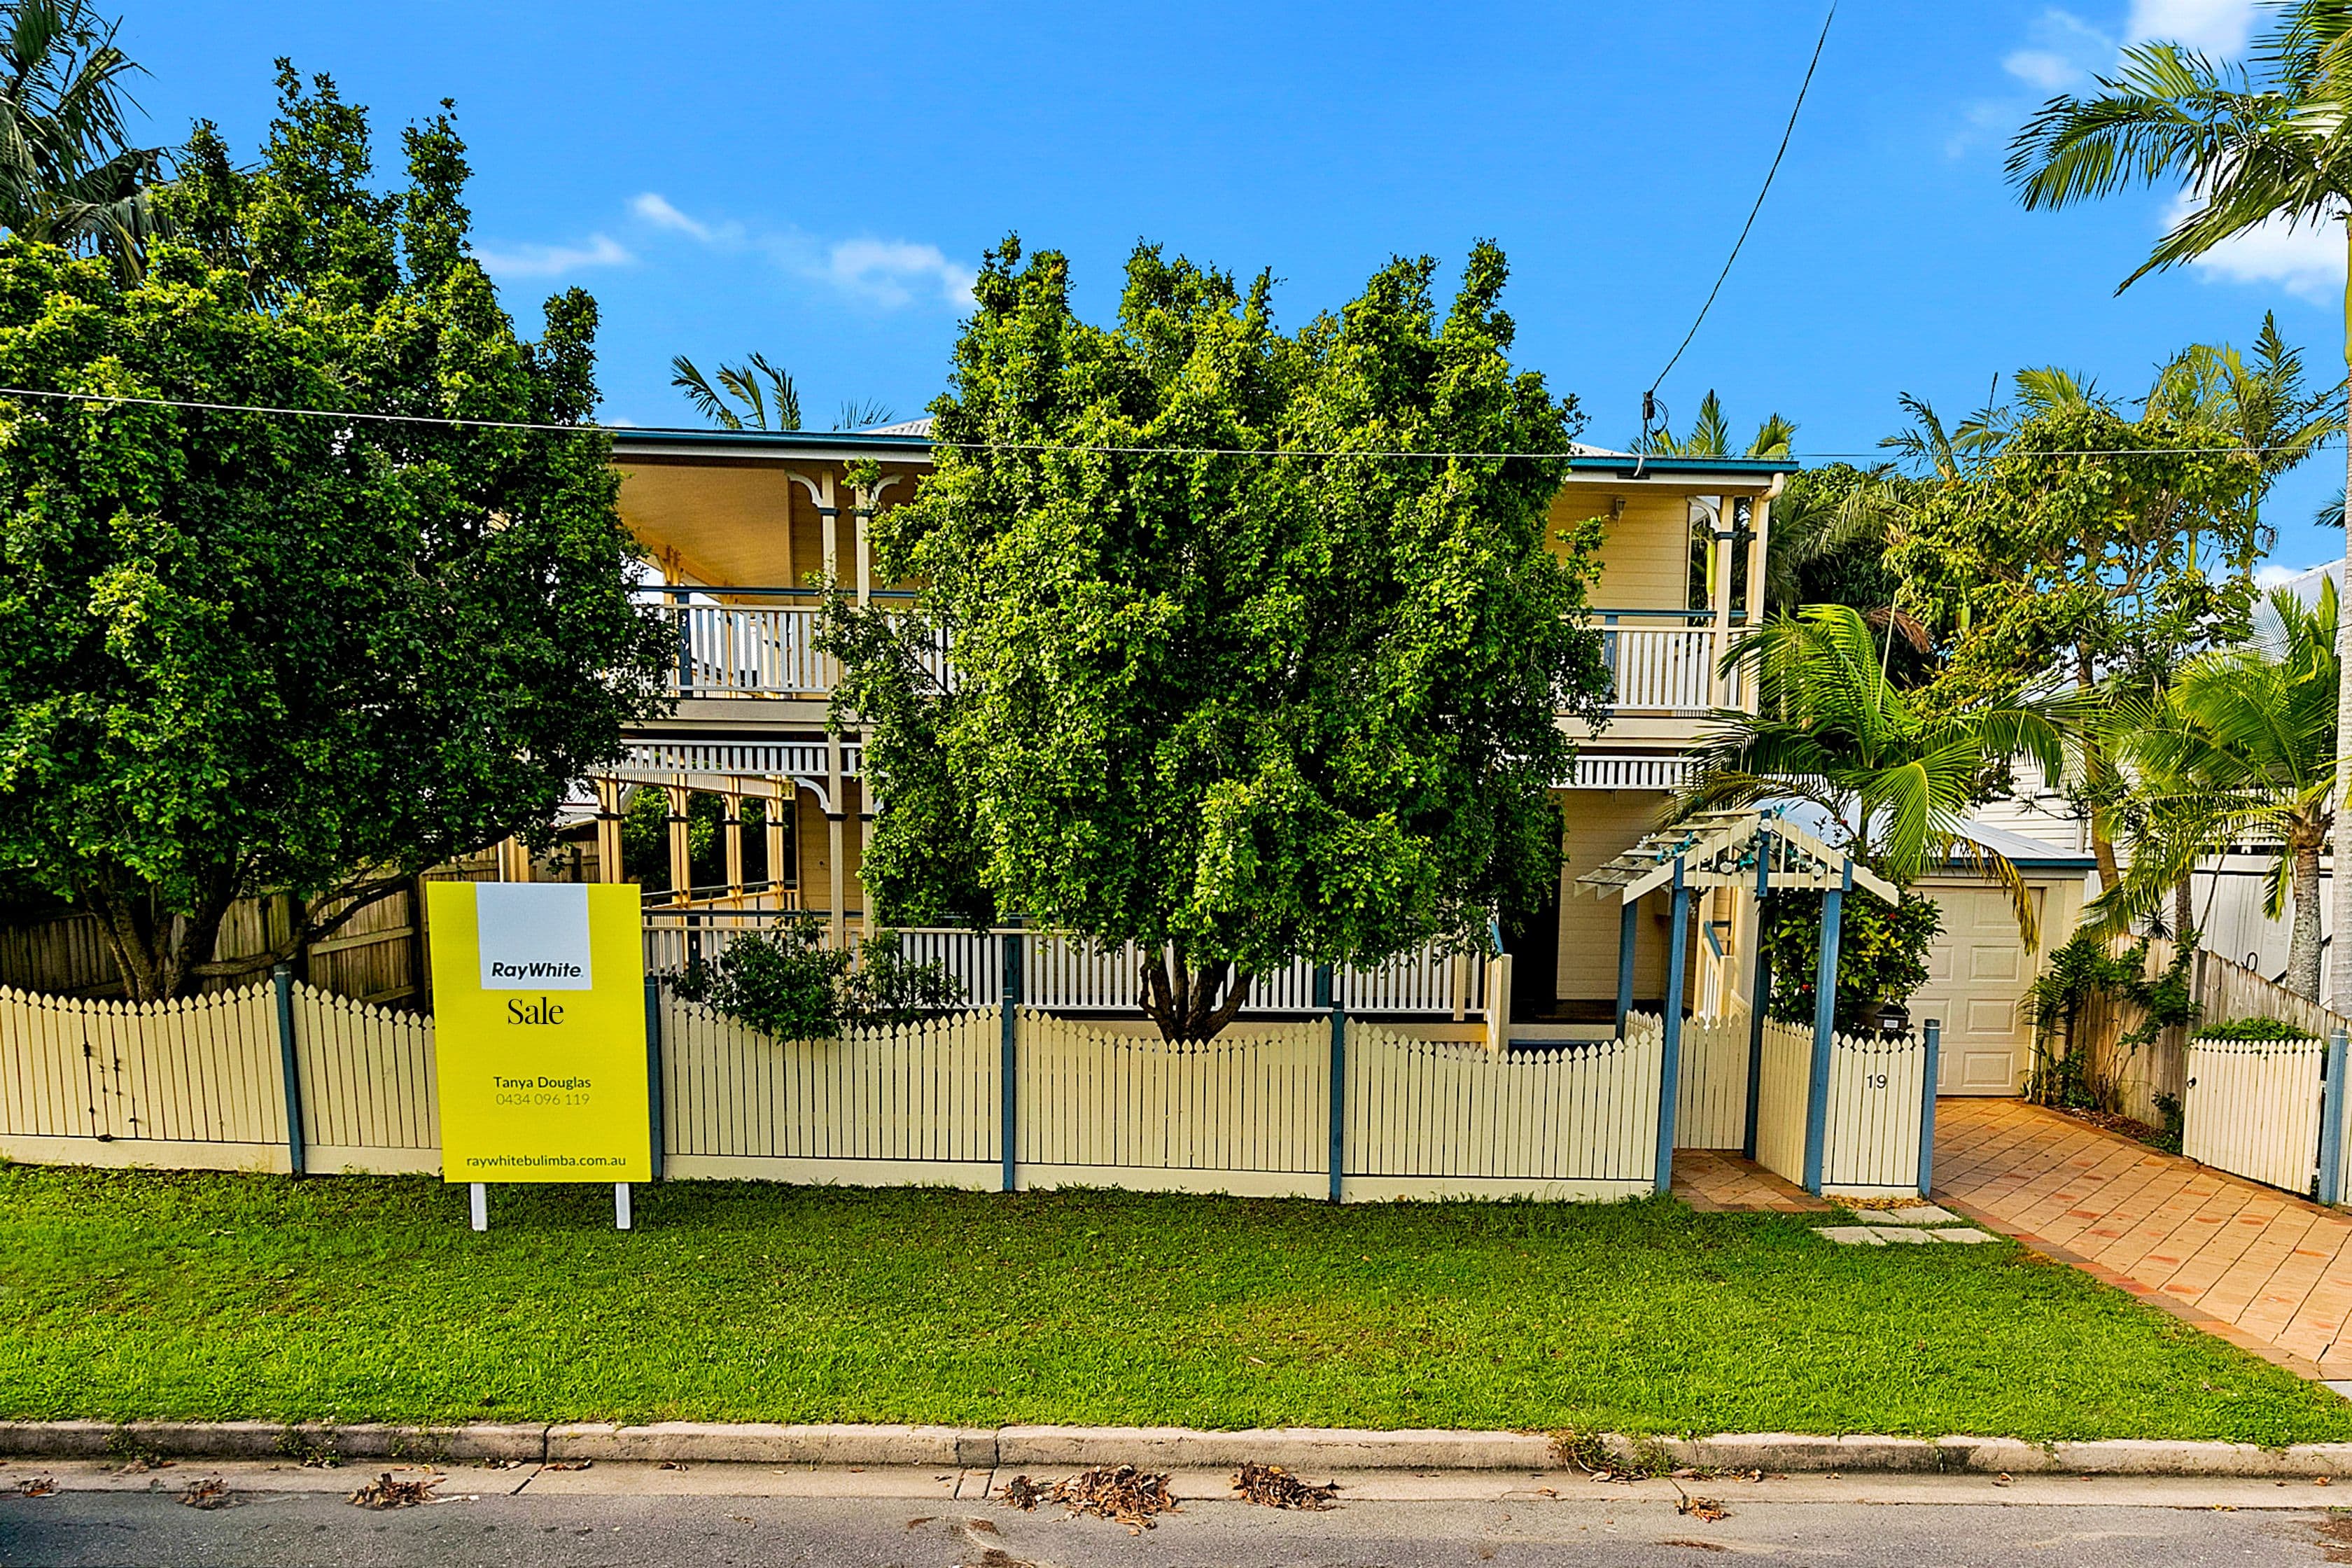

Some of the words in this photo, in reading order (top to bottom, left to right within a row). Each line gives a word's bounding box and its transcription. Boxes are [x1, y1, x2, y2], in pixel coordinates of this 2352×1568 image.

[507, 997, 564, 1025] Sale
[493, 1077, 533, 1090] Tanya
[538, 1077, 592, 1090] Douglas
[1867, 1074, 1887, 1088] 19
[496, 1093, 531, 1105] 0434
[534, 1093, 561, 1105] 096
[565, 1093, 590, 1105] 119
[466, 1155, 626, 1168] raywhitebulimba.com.au
